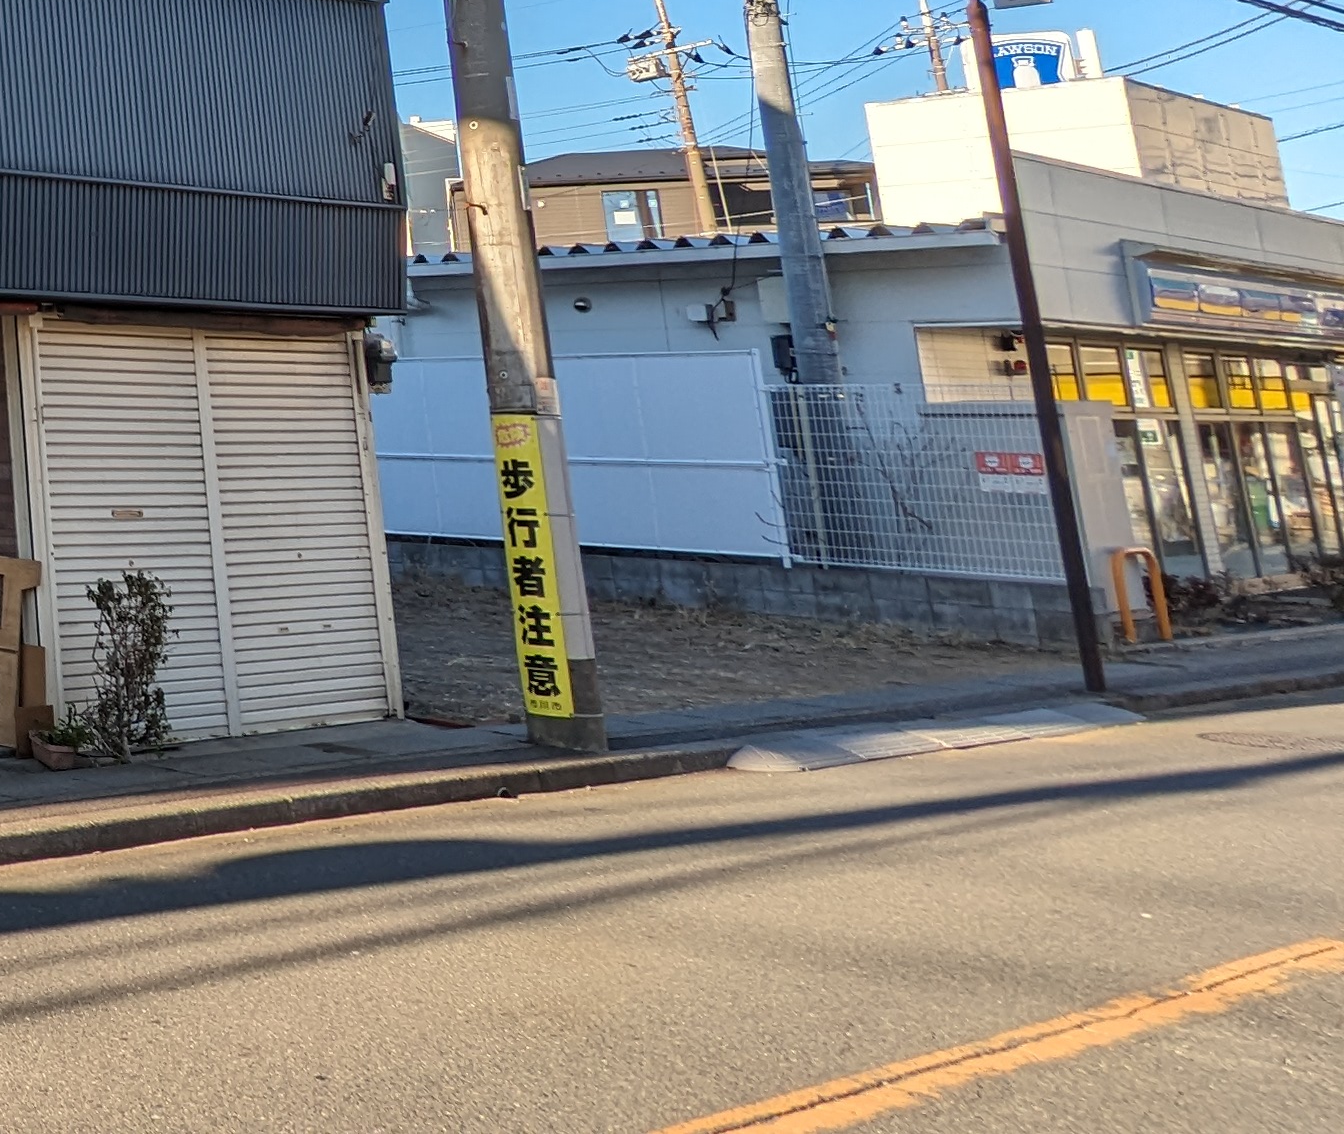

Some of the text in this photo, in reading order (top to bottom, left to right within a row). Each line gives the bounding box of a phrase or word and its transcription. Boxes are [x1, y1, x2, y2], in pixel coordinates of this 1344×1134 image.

[994, 43, 1058, 58] AWSON
[500, 459, 562, 697] 歩行者注意
